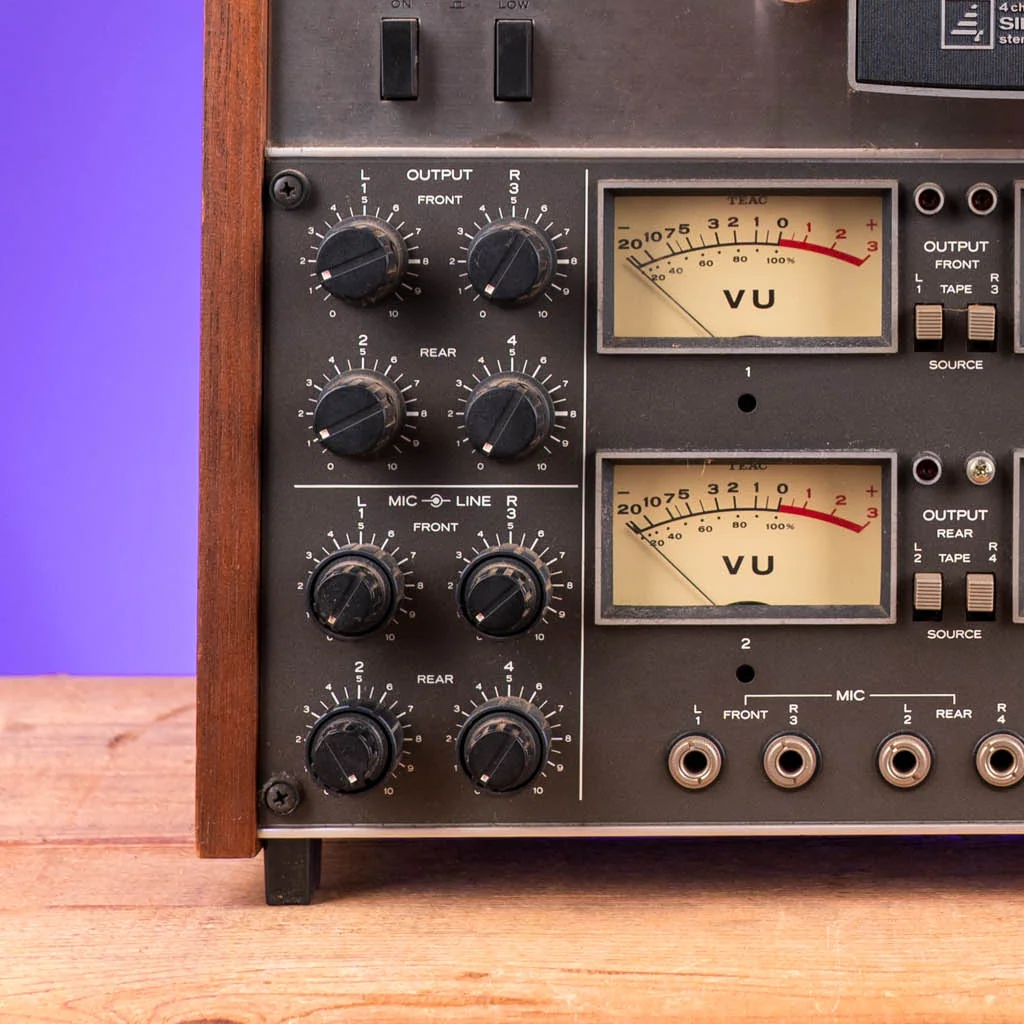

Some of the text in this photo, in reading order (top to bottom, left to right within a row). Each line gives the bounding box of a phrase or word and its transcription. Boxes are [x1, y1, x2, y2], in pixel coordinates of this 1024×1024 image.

[391, 0, 413, 9] ON
[499, 0, 529, 9] LOW
[999, 3, 1008, 12] 4
[360, 169, 371, 180] L
[406, 169, 474, 181] OUTPUT
[509, 170, 521, 180] R
[508, 183, 520, 194] 3
[417, 195, 464, 205] FRONT
[727, 196, 768, 205] TEAC
[392, 204, 400, 212] 6
[618, 239, 642, 249] 20
[644, 232, 662, 242] 10
[665, 228, 676, 238] 7
[679, 224, 690, 234] 5
[708, 219, 719, 229] 3
[728, 217, 739, 227] 2
[777, 218, 788, 228] 0
[835, 229, 846, 239] 2
[868, 241, 878, 251] 3
[923, 241, 990, 252] OUTPUT
[935, 260, 980, 269] FRONT
[915, 273, 924, 282] L
[990, 273, 1000, 282] R
[939, 285, 973, 293] TAPE
[990, 285, 999, 294] 3
[723, 290, 775, 309] VU
[358, 335, 369, 345] 2
[506, 335, 518, 345] 4
[419, 348, 457, 357] REAR
[928, 360, 984, 369] SOURCE
[356, 496, 367, 506] L
[388, 495, 492, 506] MIC LINE
[506, 496, 518, 506] R
[506, 508, 517, 519] 3
[922, 510, 989, 521] OUTPUT
[413, 523, 459, 532] FRONT
[936, 529, 974, 538] REAR
[913, 543, 923, 551] L
[988, 542, 998, 551] R
[913, 553, 922, 563] 2
[938, 554, 971, 562] TAPE
[988, 554, 998, 562] 4
[723, 556, 774, 575] VU
[927, 630, 983, 639] SOURCE
[740, 638, 751, 649] 2
[354, 661, 365, 672] 2
[503, 661, 515, 671] 4
[417, 675, 454, 683] REAR
[836, 690, 865, 701] MIC
[693, 705, 702, 713] L
[788, 704, 799, 713] R
[903, 704, 913, 712] L
[997, 703, 1007, 712] R
[723, 710, 769, 719] FRONT
[935, 709, 973, 718] REAR
[789, 716, 798, 725] 3
[903, 715, 912, 724] 2
[996, 715, 1006, 723] 4
